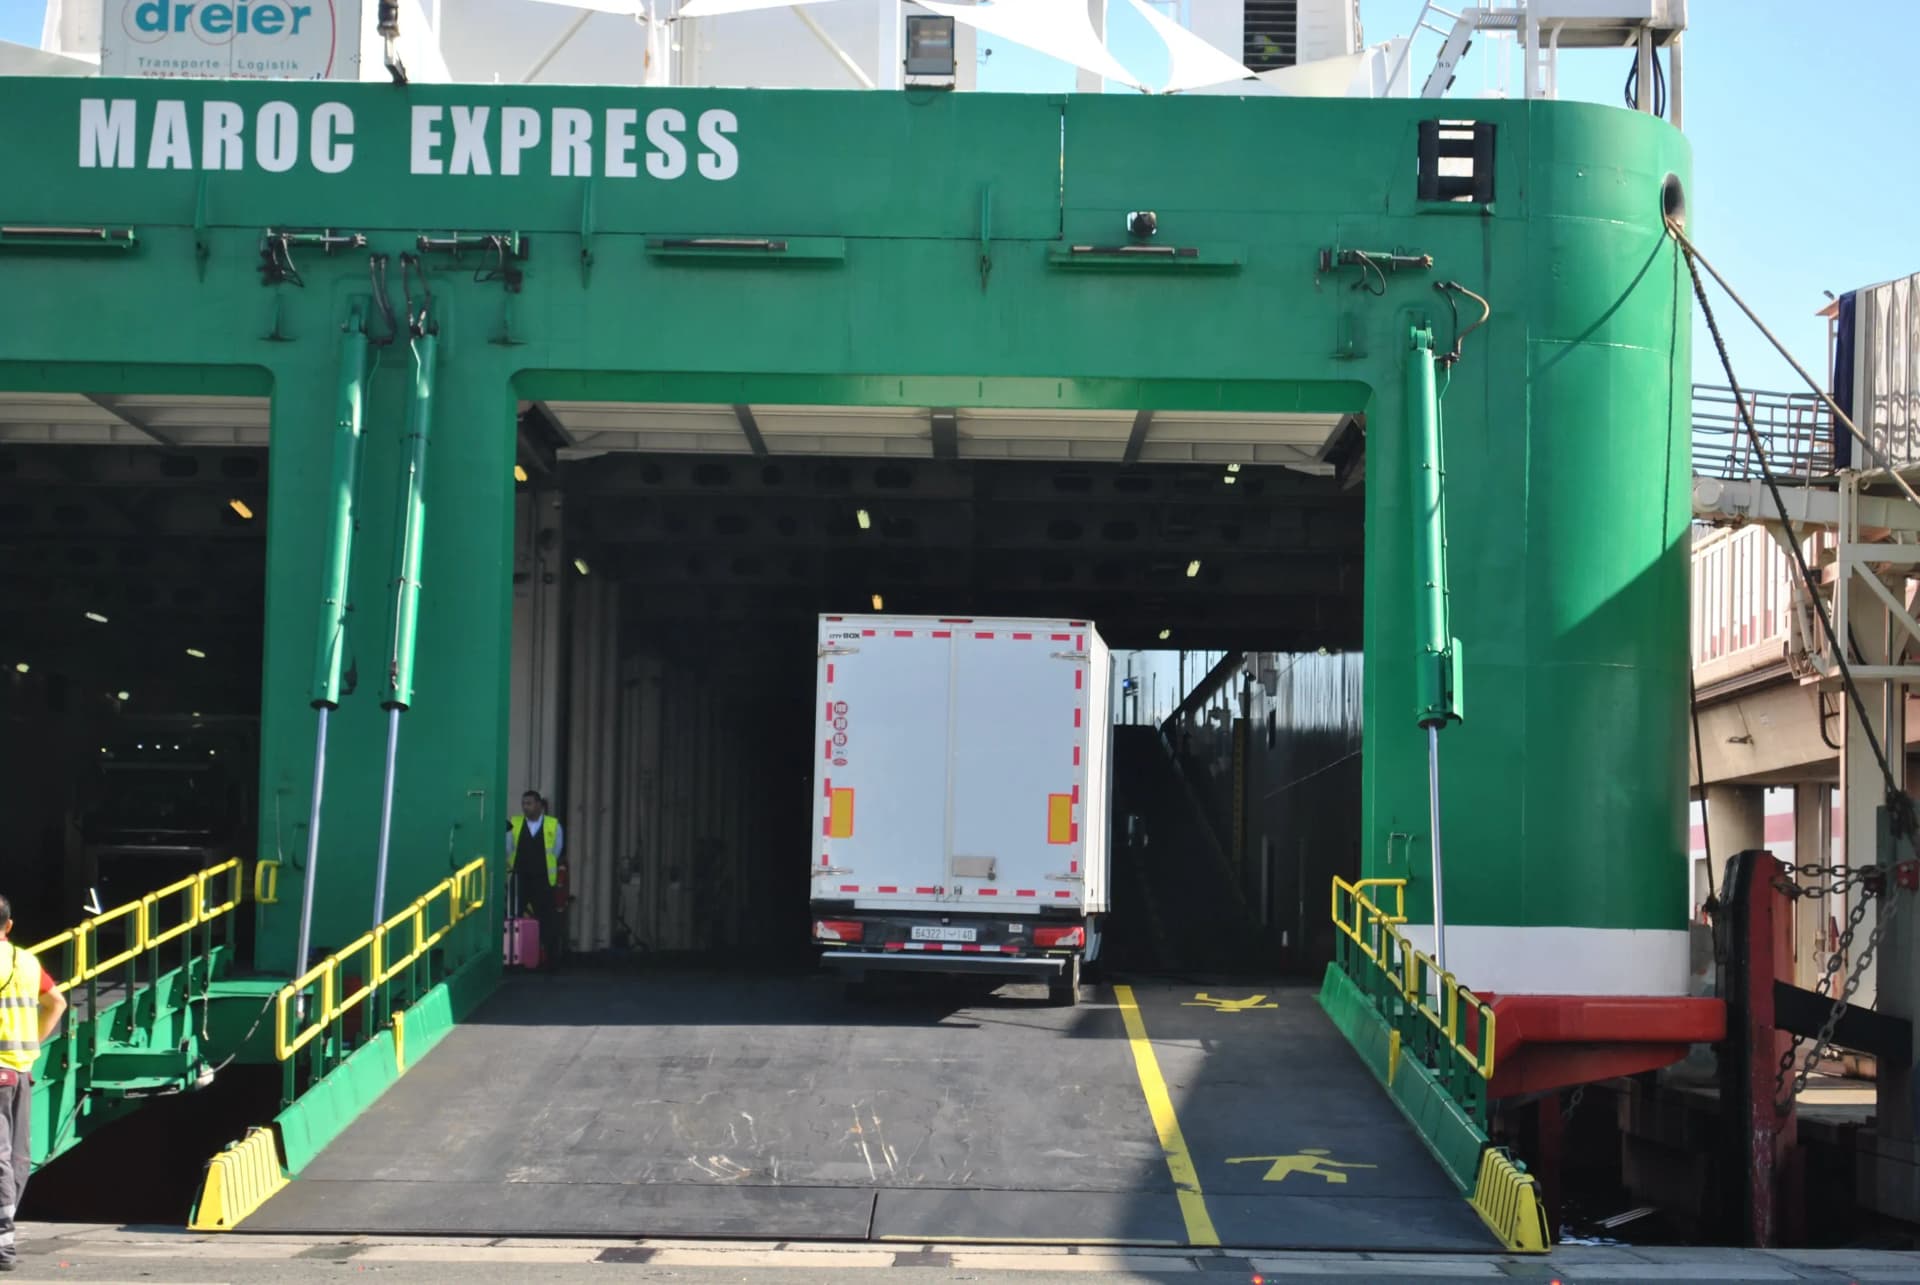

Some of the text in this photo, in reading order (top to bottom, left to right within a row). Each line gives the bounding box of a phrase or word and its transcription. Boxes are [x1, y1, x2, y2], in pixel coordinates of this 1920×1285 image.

[135, 0, 311, 35] dreier
[138, 57, 299, 71] Transporte Logistik
[79, 98, 739, 181] MAROC EXPRESS
